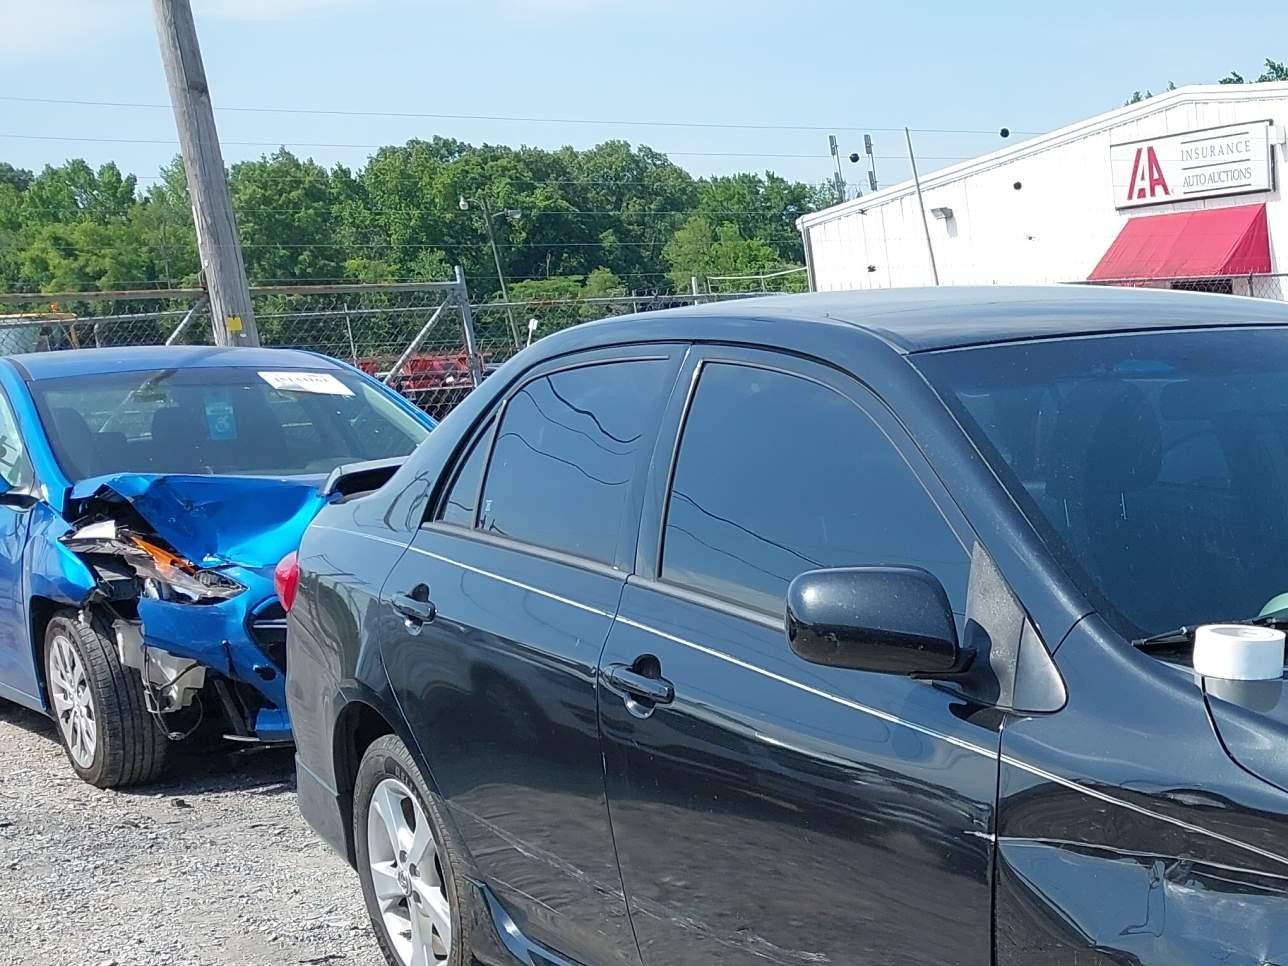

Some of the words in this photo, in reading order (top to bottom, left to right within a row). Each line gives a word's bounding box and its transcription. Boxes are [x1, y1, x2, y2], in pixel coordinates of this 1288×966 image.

[1181, 139, 1251, 162] INSURANCE
[1183, 172, 1207, 189] AUTO
[1207, 167, 1252, 185] AUCTIONS
